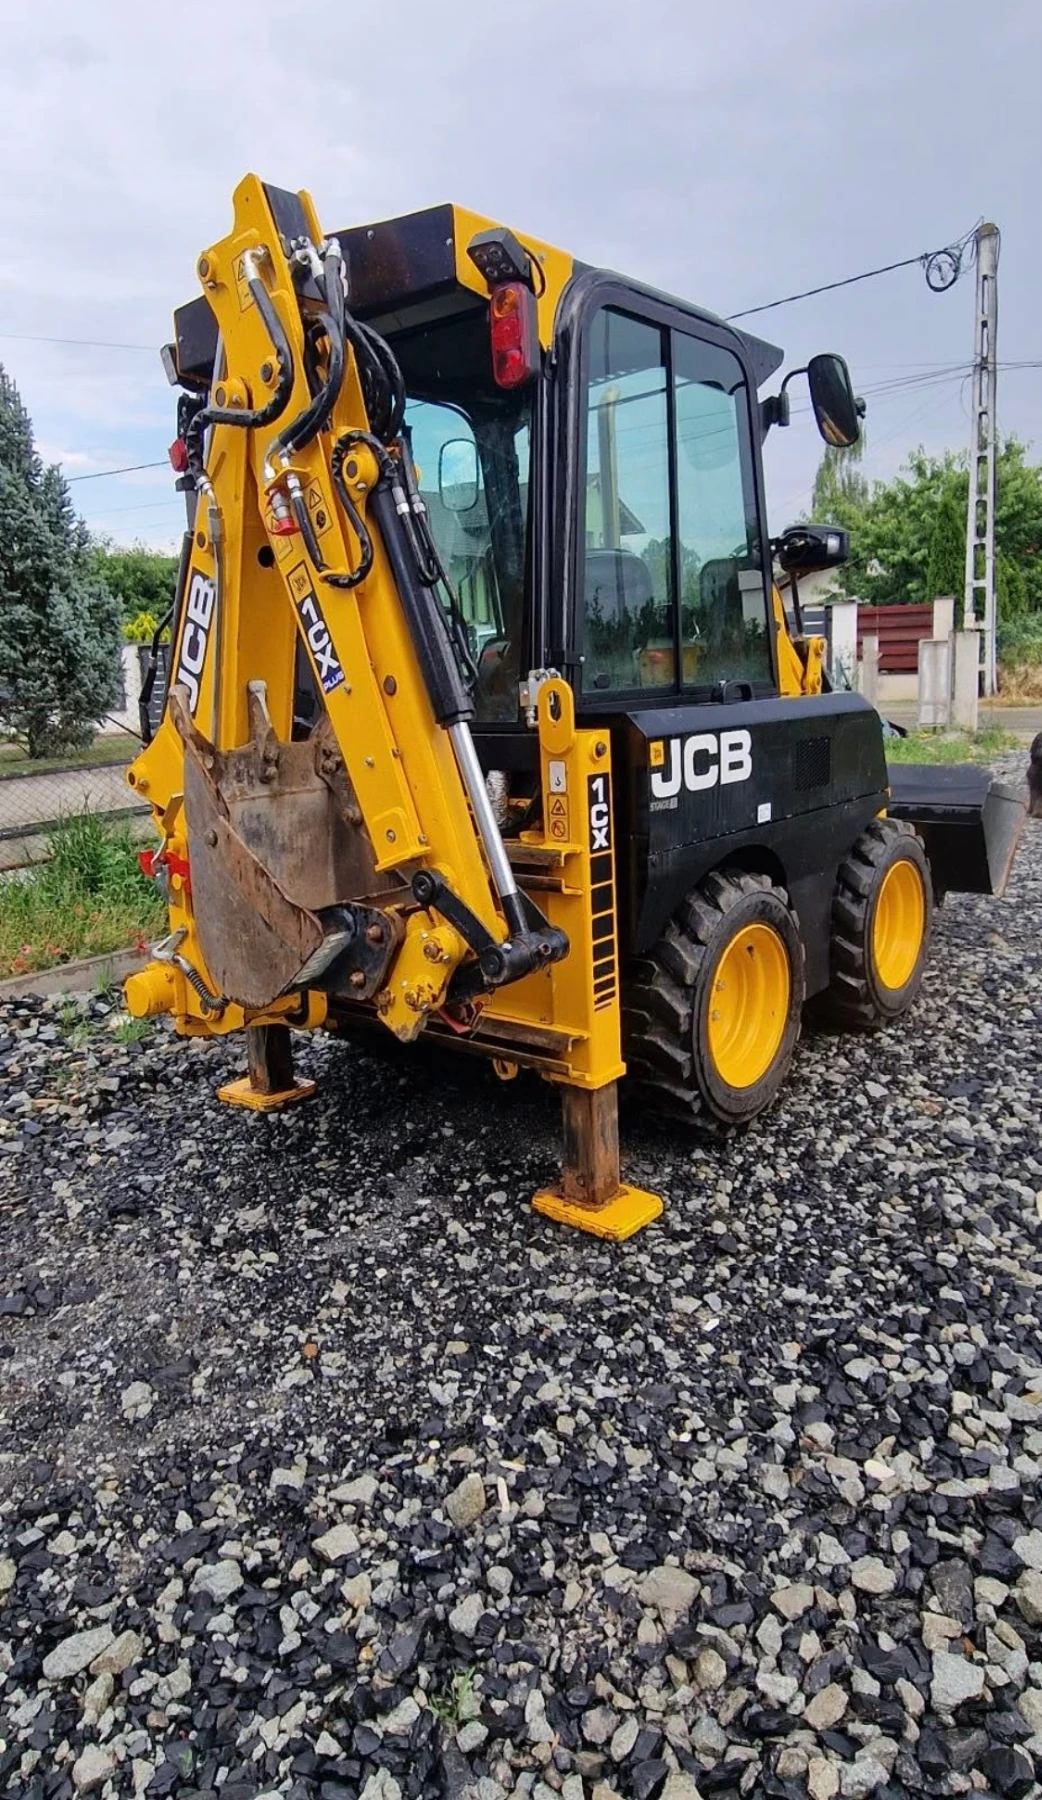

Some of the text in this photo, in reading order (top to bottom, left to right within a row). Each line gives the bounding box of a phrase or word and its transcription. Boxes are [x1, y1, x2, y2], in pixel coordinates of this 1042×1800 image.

[178, 575, 214, 713] JCB
[301, 597, 340, 679] 1CX
[322, 671, 345, 691] PLUS
[651, 729, 752, 798] JCB
[590, 777, 609, 850] 1CX
